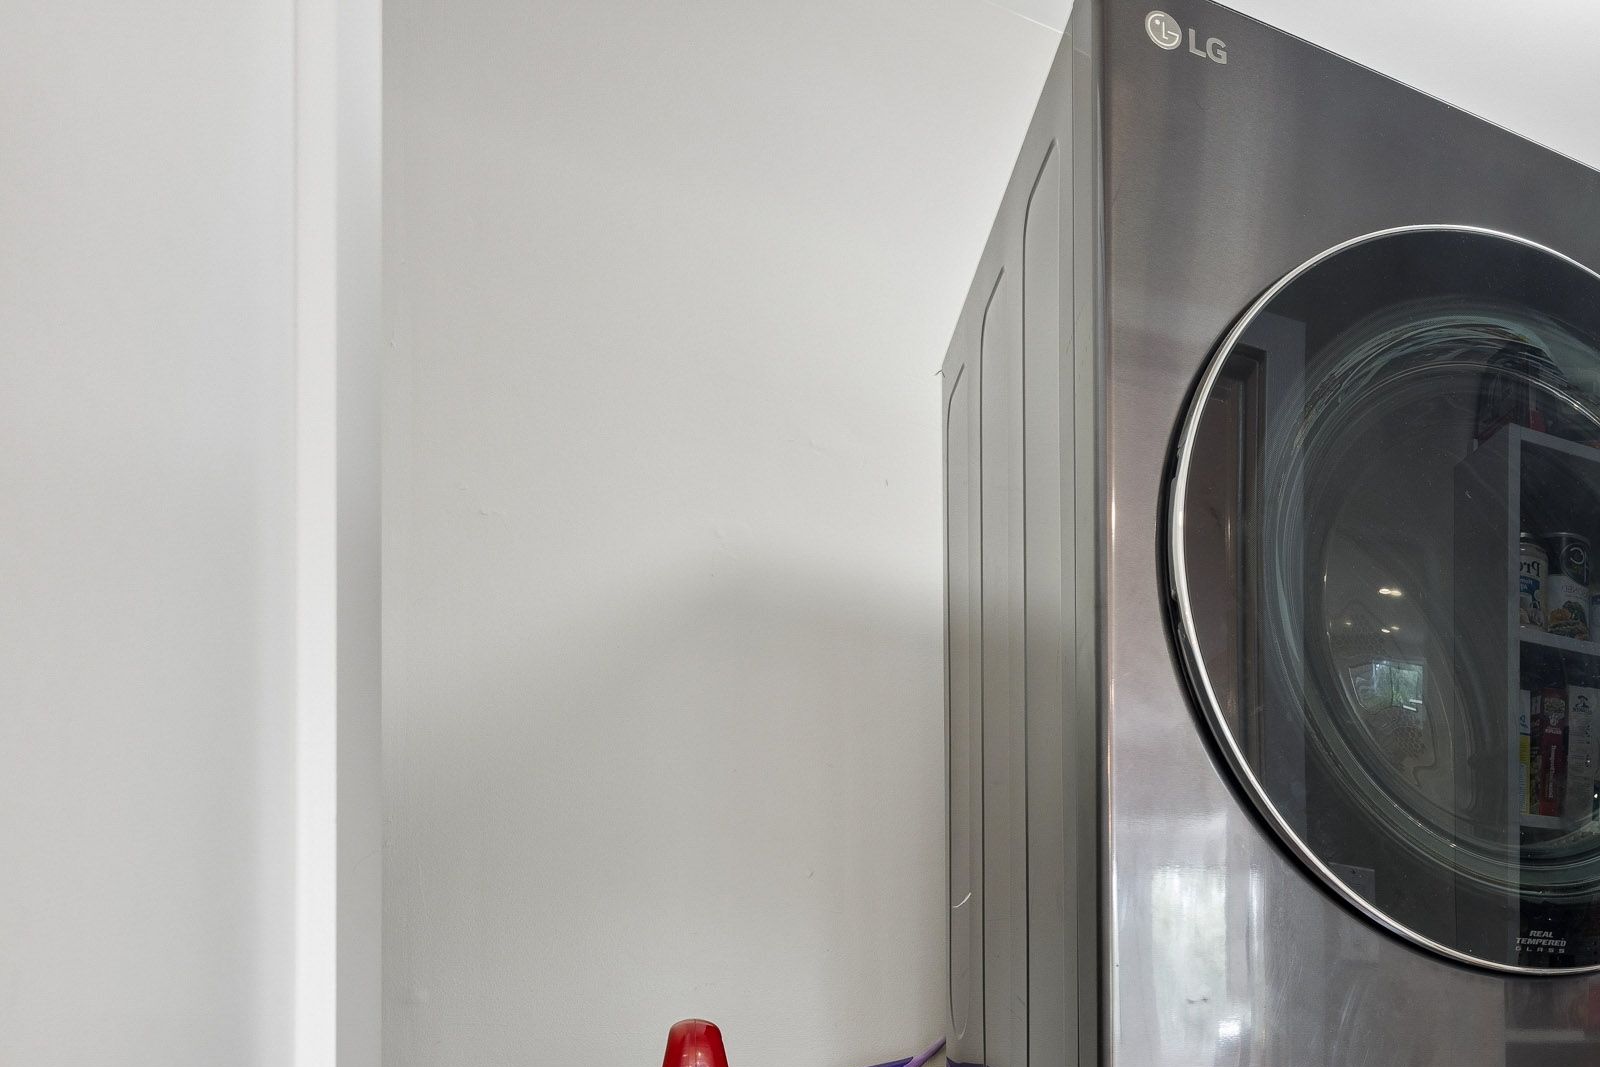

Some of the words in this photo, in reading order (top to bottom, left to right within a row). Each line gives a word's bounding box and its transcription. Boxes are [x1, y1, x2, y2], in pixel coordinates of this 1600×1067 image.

[1188, 28, 1228, 65] LG
[1529, 930, 1554, 938] REAL
[1516, 937, 1567, 947] TEMPERED
